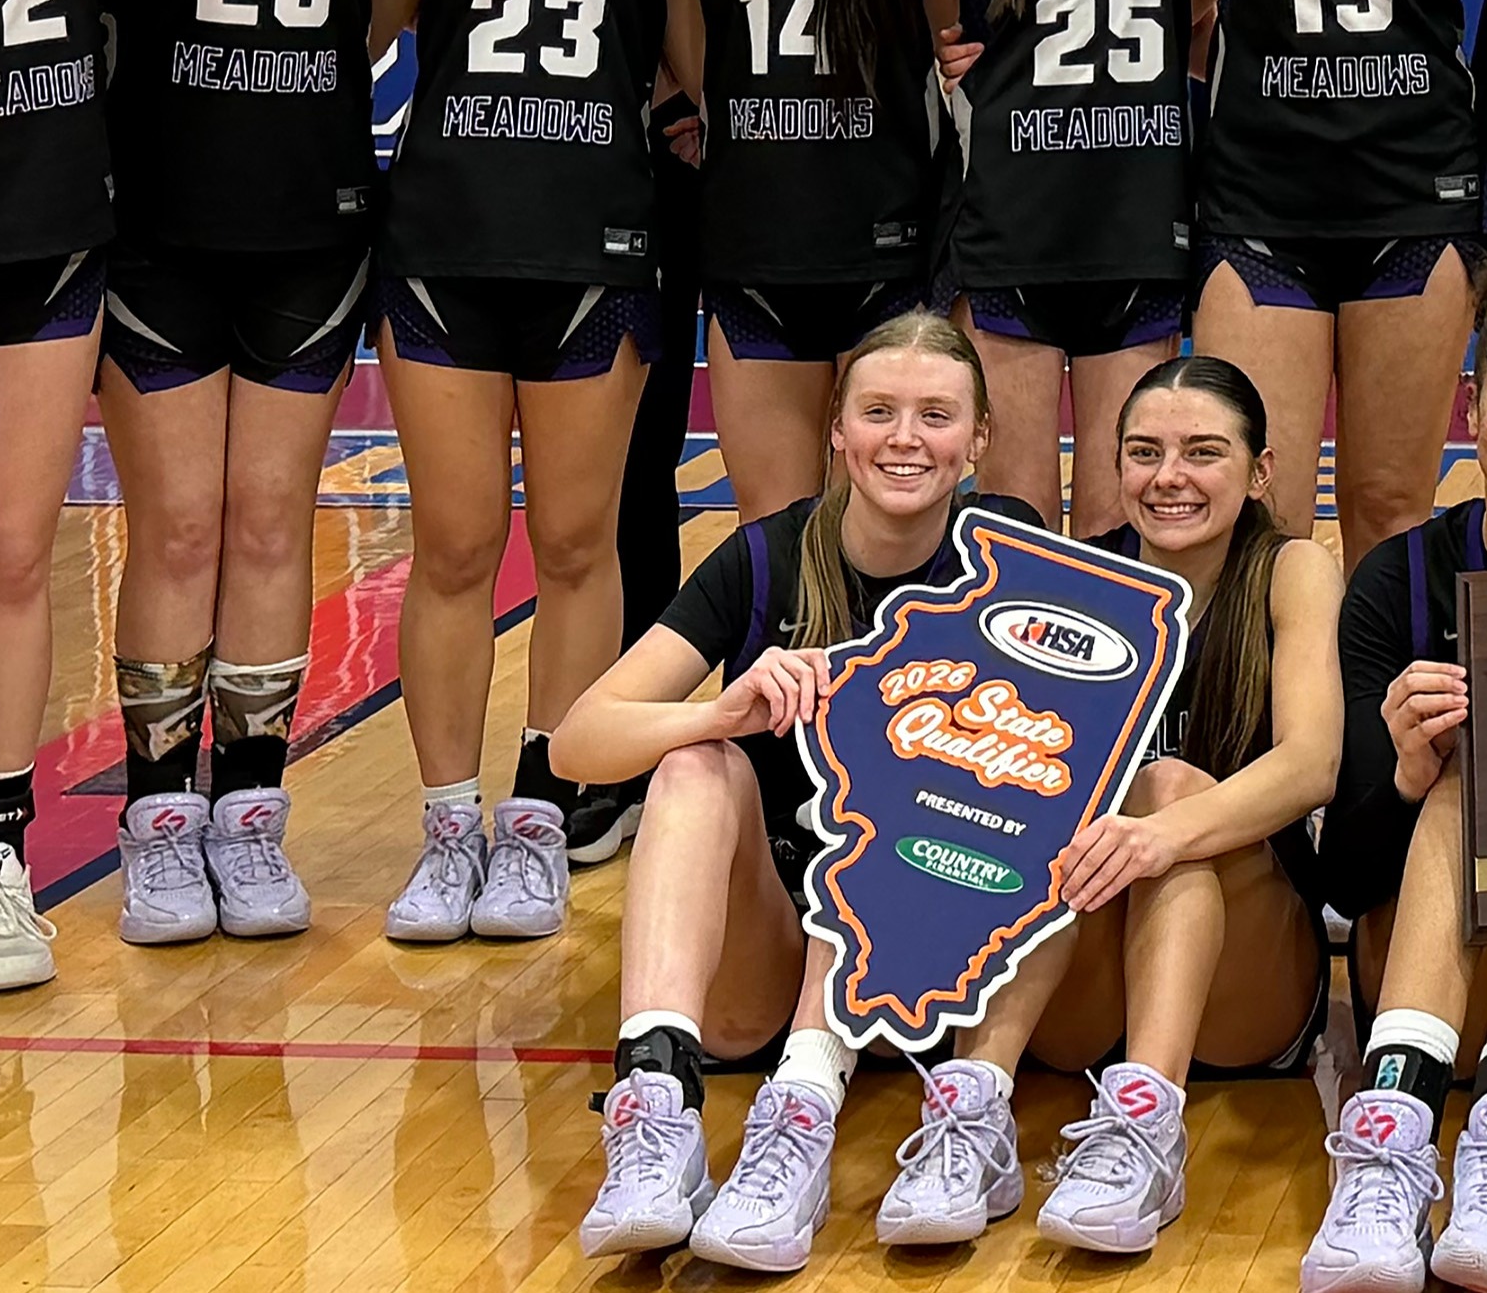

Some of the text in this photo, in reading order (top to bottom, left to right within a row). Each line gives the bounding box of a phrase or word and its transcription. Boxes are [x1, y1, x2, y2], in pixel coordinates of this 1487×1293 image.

[172, 42, 337, 93] MEADOWS
[1263, 54, 1430, 100] MEADOWS
[442, 95, 613, 145] MEADOWS
[729, 97, 873, 141] MEADOWS
[1011, 105, 1182, 152] MEADOWS
[886, 664, 971, 700] 2026
[962, 686, 1064, 747] State
[895, 704, 1063, 789] Qualifier
[916, 790, 1027, 836] PRESENTED BY
[912, 839, 1010, 883] COUNTRY
